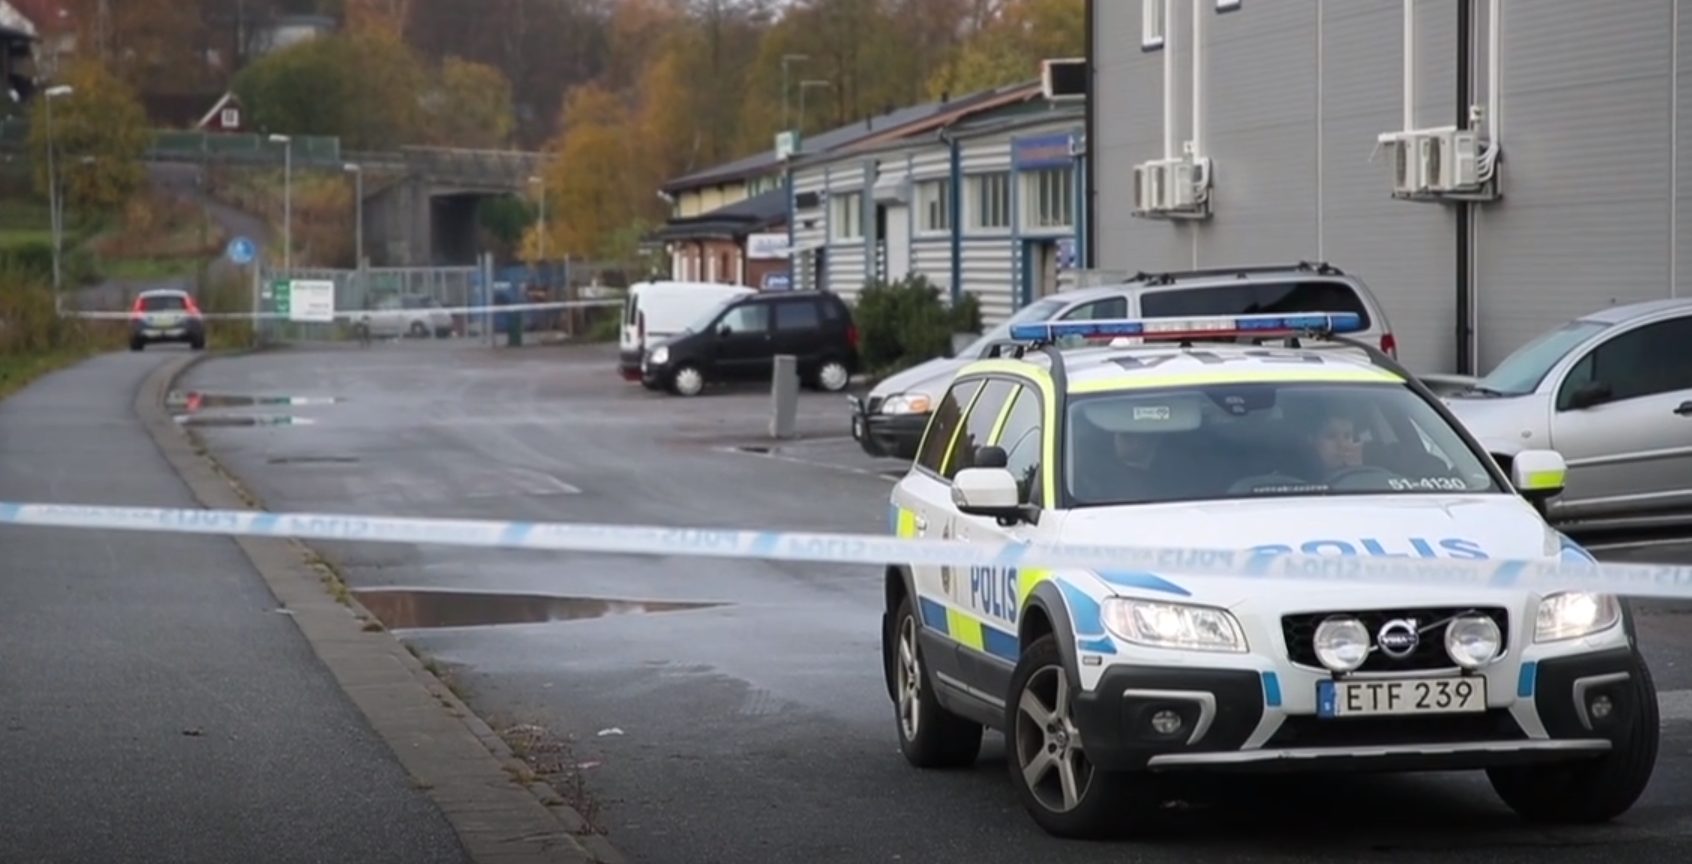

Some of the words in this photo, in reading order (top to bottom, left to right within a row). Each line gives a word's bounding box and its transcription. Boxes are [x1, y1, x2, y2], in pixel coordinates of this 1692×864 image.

[1388, 477, 1466, 490] 51-4130
[970, 565, 1017, 624] POLIS
[1347, 683, 1402, 711] ETF
[1415, 681, 1472, 709] 239
